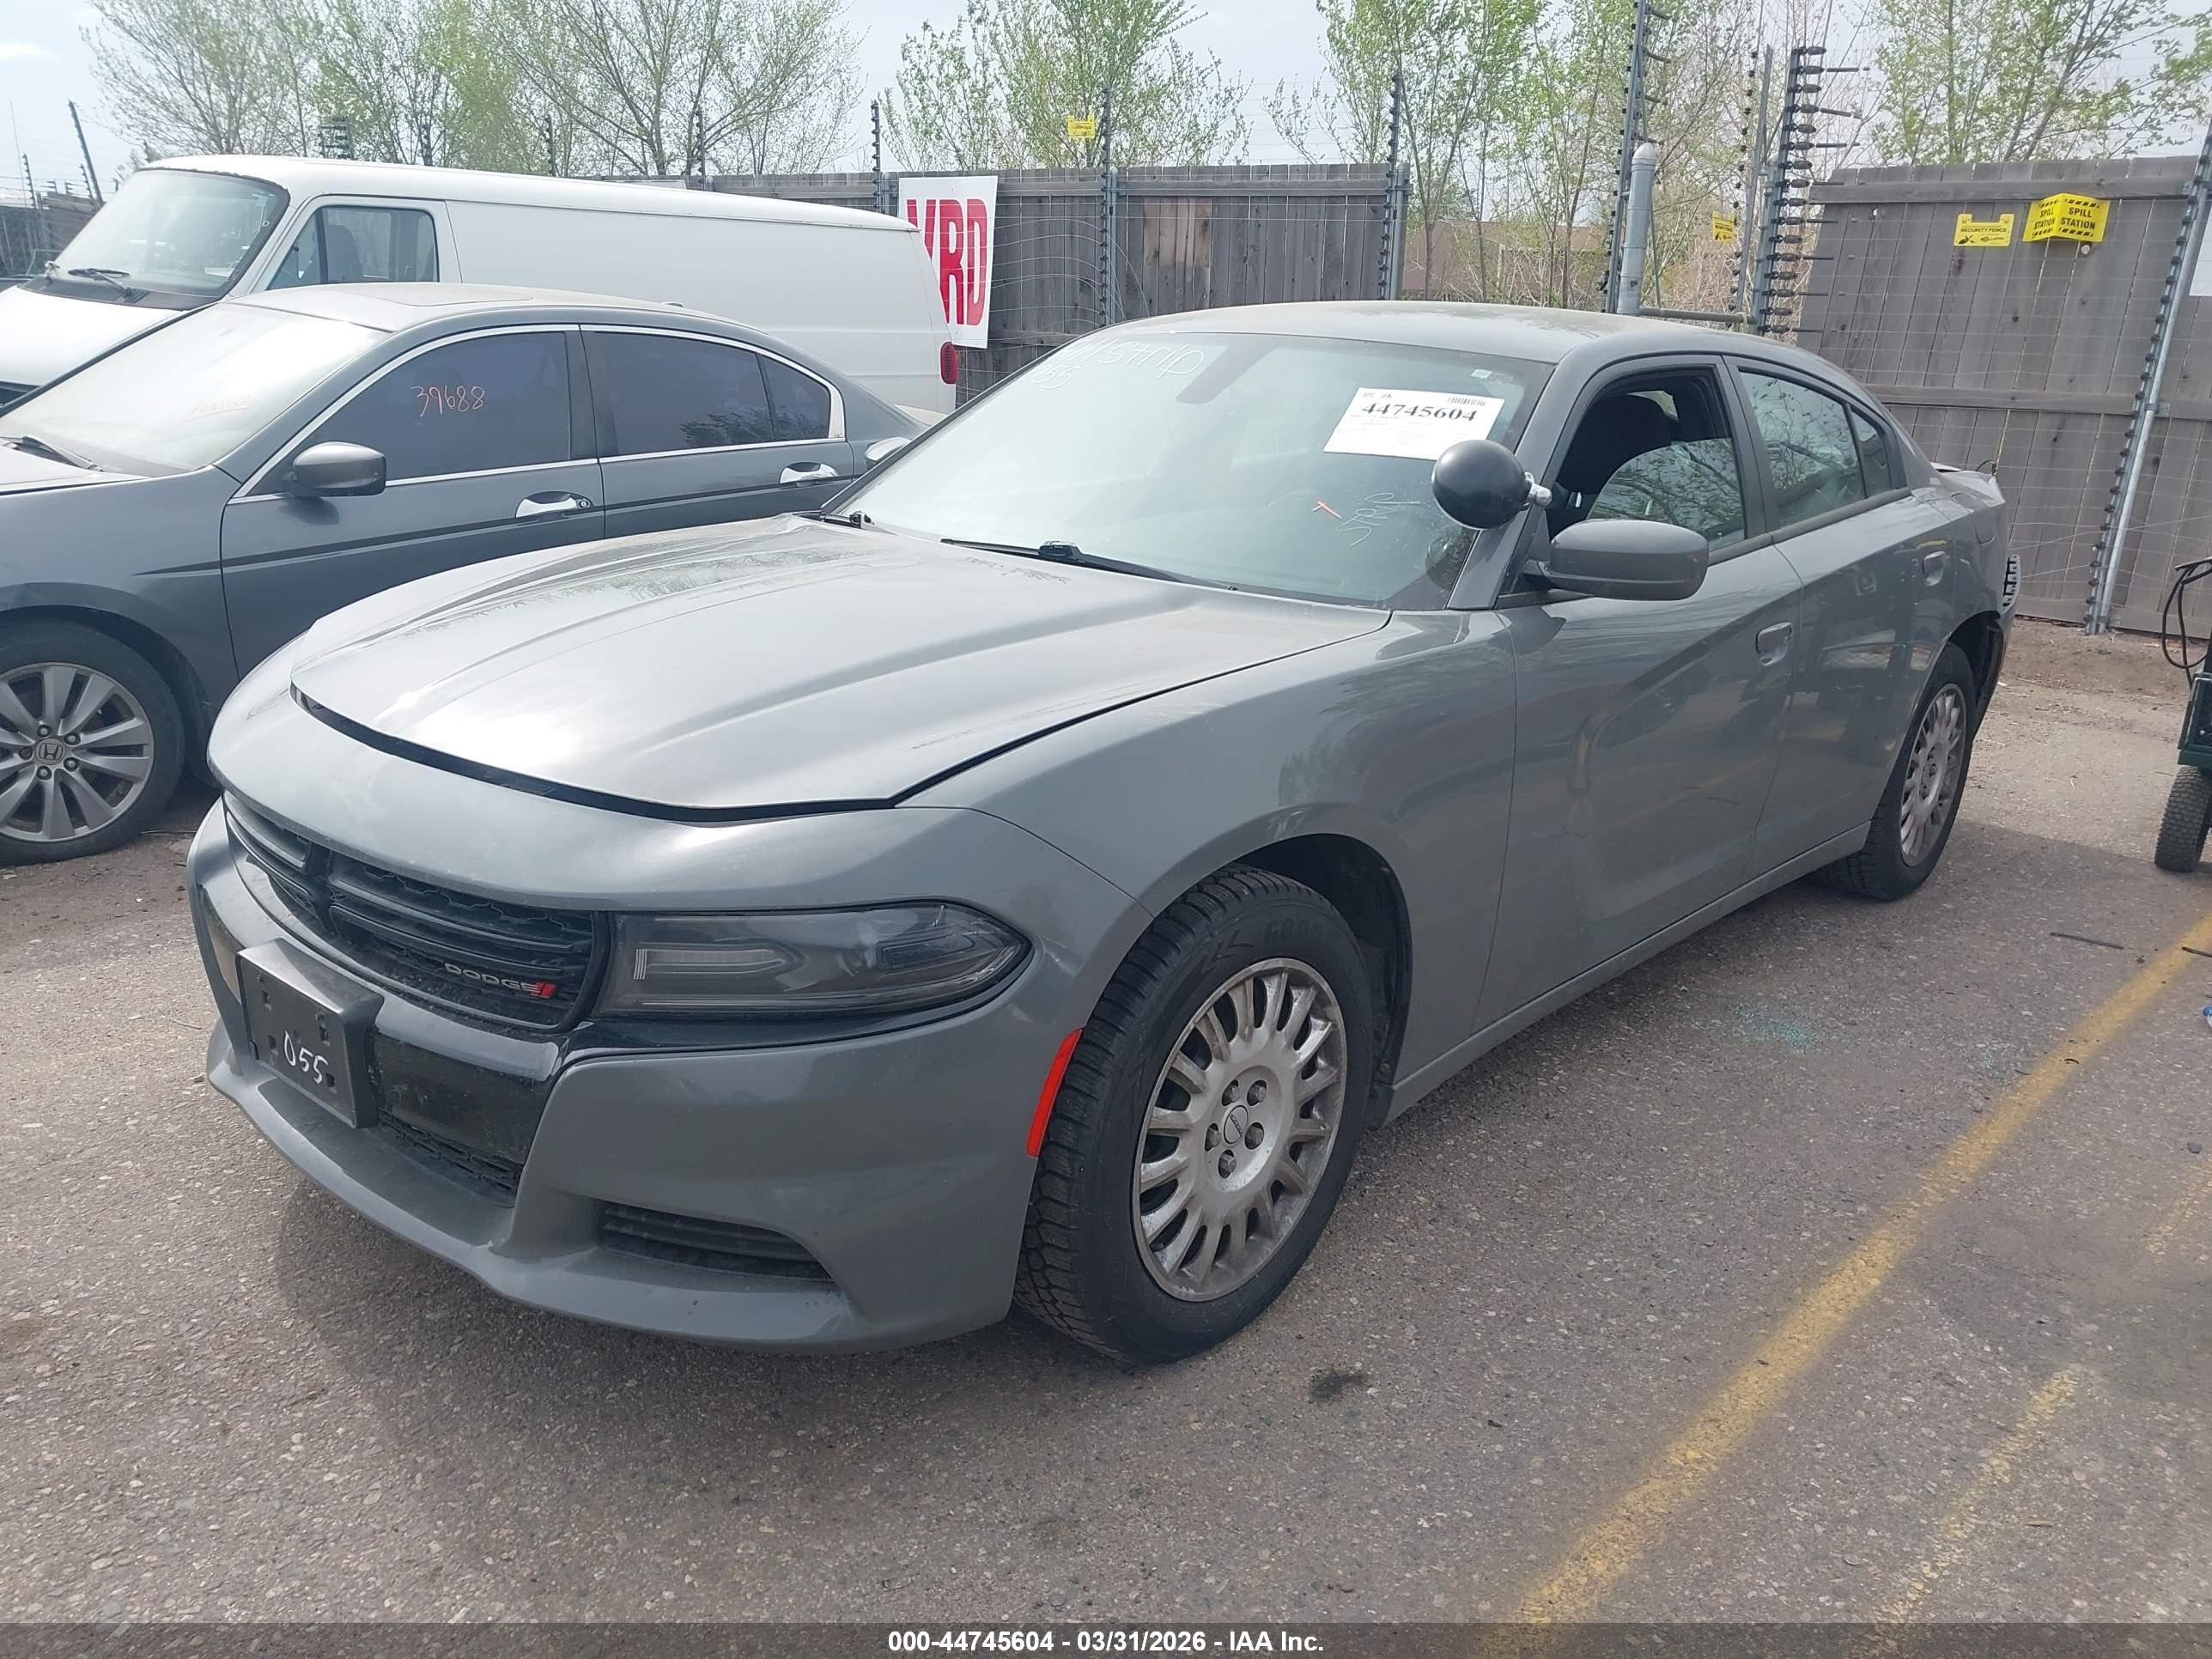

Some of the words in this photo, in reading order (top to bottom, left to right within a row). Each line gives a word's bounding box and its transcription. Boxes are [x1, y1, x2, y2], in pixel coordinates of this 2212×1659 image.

[2040, 208, 2055, 218] SPILL
[2069, 207, 2093, 218] SPILL
[2060, 217, 2096, 230] STATION
[410, 384, 486, 417] 39688
[1362, 402, 1479, 422] 44745604
[444, 962, 541, 994] DODGE
[283, 1030, 329, 1085] 055
